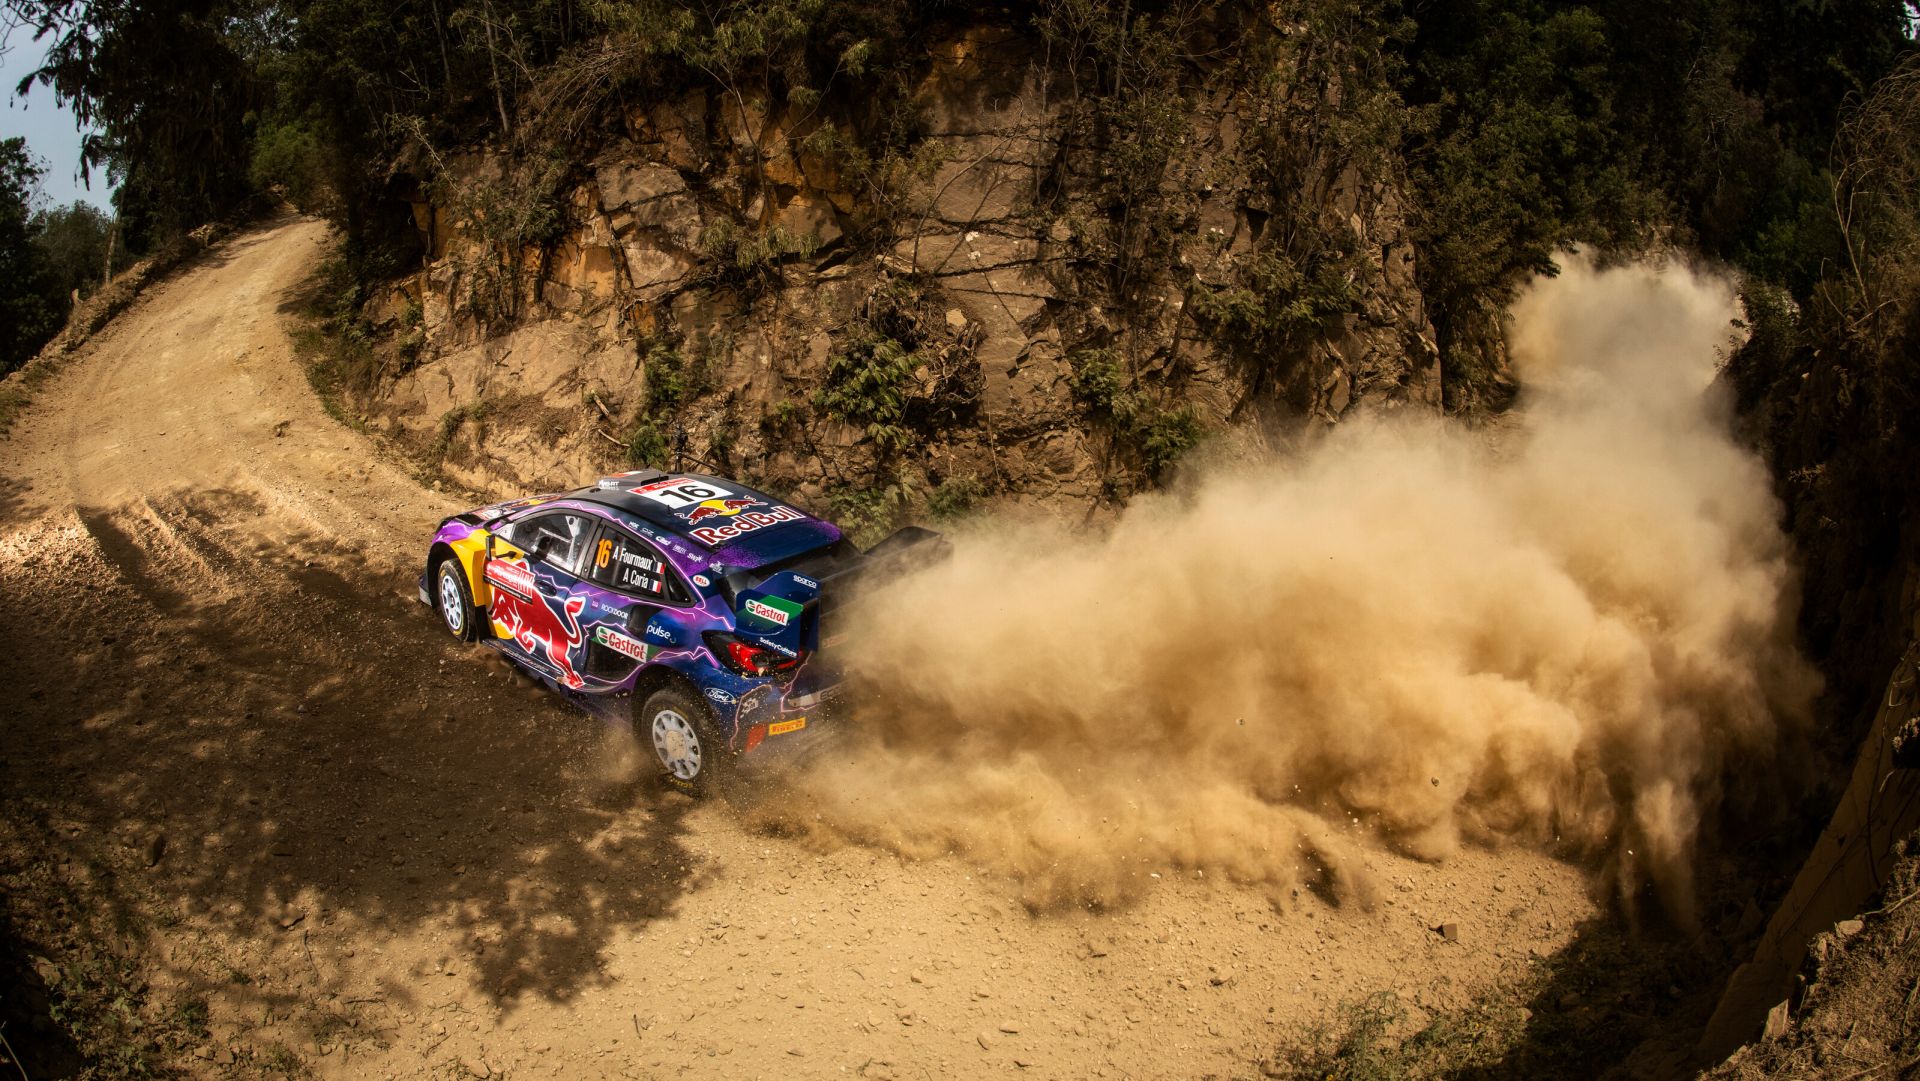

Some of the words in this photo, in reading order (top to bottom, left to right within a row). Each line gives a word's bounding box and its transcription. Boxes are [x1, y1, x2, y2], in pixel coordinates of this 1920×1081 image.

[660, 486, 716, 502] 16
[596, 539, 612, 568] 16
[612, 545, 619, 560] A
[619, 547, 653, 571] Fourmaux
[623, 567, 629, 583] A
[630, 570, 648, 589] Coria
[695, 576, 707, 585] BELL
[793, 575, 817, 588] sparco
[755, 604, 786, 623] Castrol
[646, 625, 671, 639] pulse
[608, 633, 645, 660] Castrol
[760, 637, 797, 658] SafetyCulture
